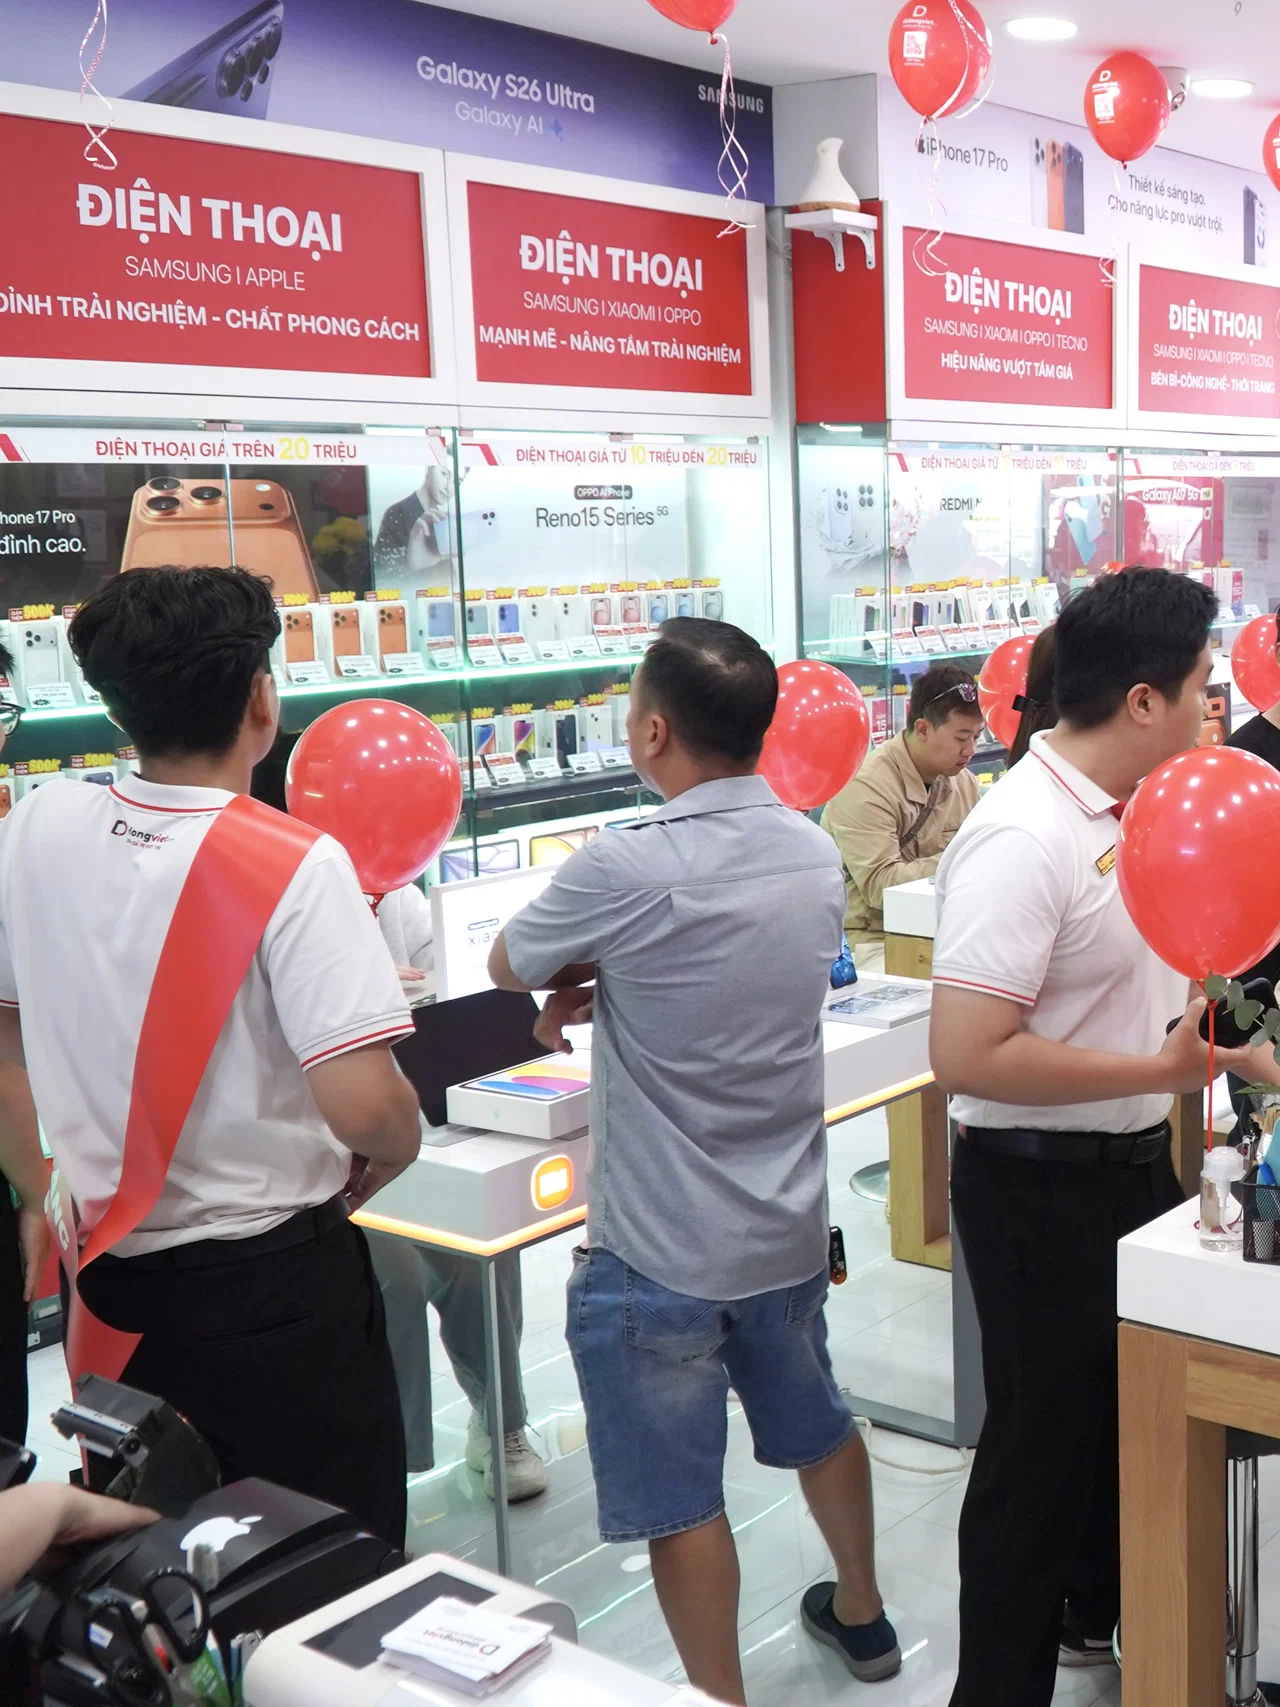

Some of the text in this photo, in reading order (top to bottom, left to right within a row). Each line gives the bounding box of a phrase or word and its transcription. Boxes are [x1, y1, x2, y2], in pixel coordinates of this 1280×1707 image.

[416, 56, 595, 113] Galaxy S26 Ultra
[698, 84, 764, 114] SAMSUNG
[455, 101, 543, 135] Galaxy AI
[926, 137, 1008, 172] iPhone 17 Pro
[1129, 174, 1152, 194] Thiết
[1154, 179, 1165, 196] kế
[1167, 186, 1188, 204] sáng
[76, 177, 343, 261] ĐIỆN THOẠI
[1108, 194, 1128, 212] Cho
[1130, 200, 1153, 220] năng
[1171, 211, 1185, 224] pro
[125, 256, 305, 291] SAMSUNG APPLE
[519, 230, 702, 298] ĐIỆN THOẠI
[523, 291, 701, 326] SAMSUNG XIAOMI OPPO
[944, 267, 1072, 326] ĐIỆN THOẠI
[57, 292, 112, 320] TRẢI
[117, 299, 207, 330] NGHIỆM
[226, 305, 282, 332] CHẤT
[288, 315, 360, 338] PHONG
[364, 315, 419, 341] CÁCH
[1169, 299, 1262, 347] ĐIỆN THOẠI
[480, 325, 529, 349] MẠNH
[533, 328, 557, 348] MẼ
[570, 331, 615, 354] NÂNG
[686, 343, 741, 366] NGHIỆM
[924, 317, 1087, 351] SAMSUNG XIAOMI OPPO TECNO
[941, 350, 968, 372] HIỆU
[969, 353, 1000, 373] NĂNG
[1002, 358, 1032, 378] VƯỢT
[1056, 363, 1073, 380] GIÁ
[1153, 343, 1274, 368] SAMSUNG XIAOMI OPPO TECNO
[1250, 380, 1275, 394] TRANG
[95, 437, 357, 461] ĐIỆN THOẠI GIÁ TRÊN 20 TRIỆU
[516, 445, 757, 467] ĐIỆN THOẠI GIÁ TỪ 10 TRIỆU ĐẾN 20 TRIỆU
[921, 455, 942, 471] ĐIỆN
[944, 457, 970, 472] THOẠI
[972, 456, 986, 469] GIÁ
[987, 456, 999, 469] TỪ
[1012, 456, 1034, 471] TRIỆU
[1036, 456, 1051, 469] ĐẾN
[1066, 456, 1087, 471] TRIỆU
[577, 488, 599, 497] OPPO
[940, 498, 972, 511] REDMI
[1142, 488, 1172, 503] Galaxy
[1187, 488, 1199, 500] 5G
[35, 510, 50, 524] 17
[52, 510, 76, 523] Pro
[536, 505, 669, 528] Reno15 Series 5G
[45, 537, 86, 553] cao.
